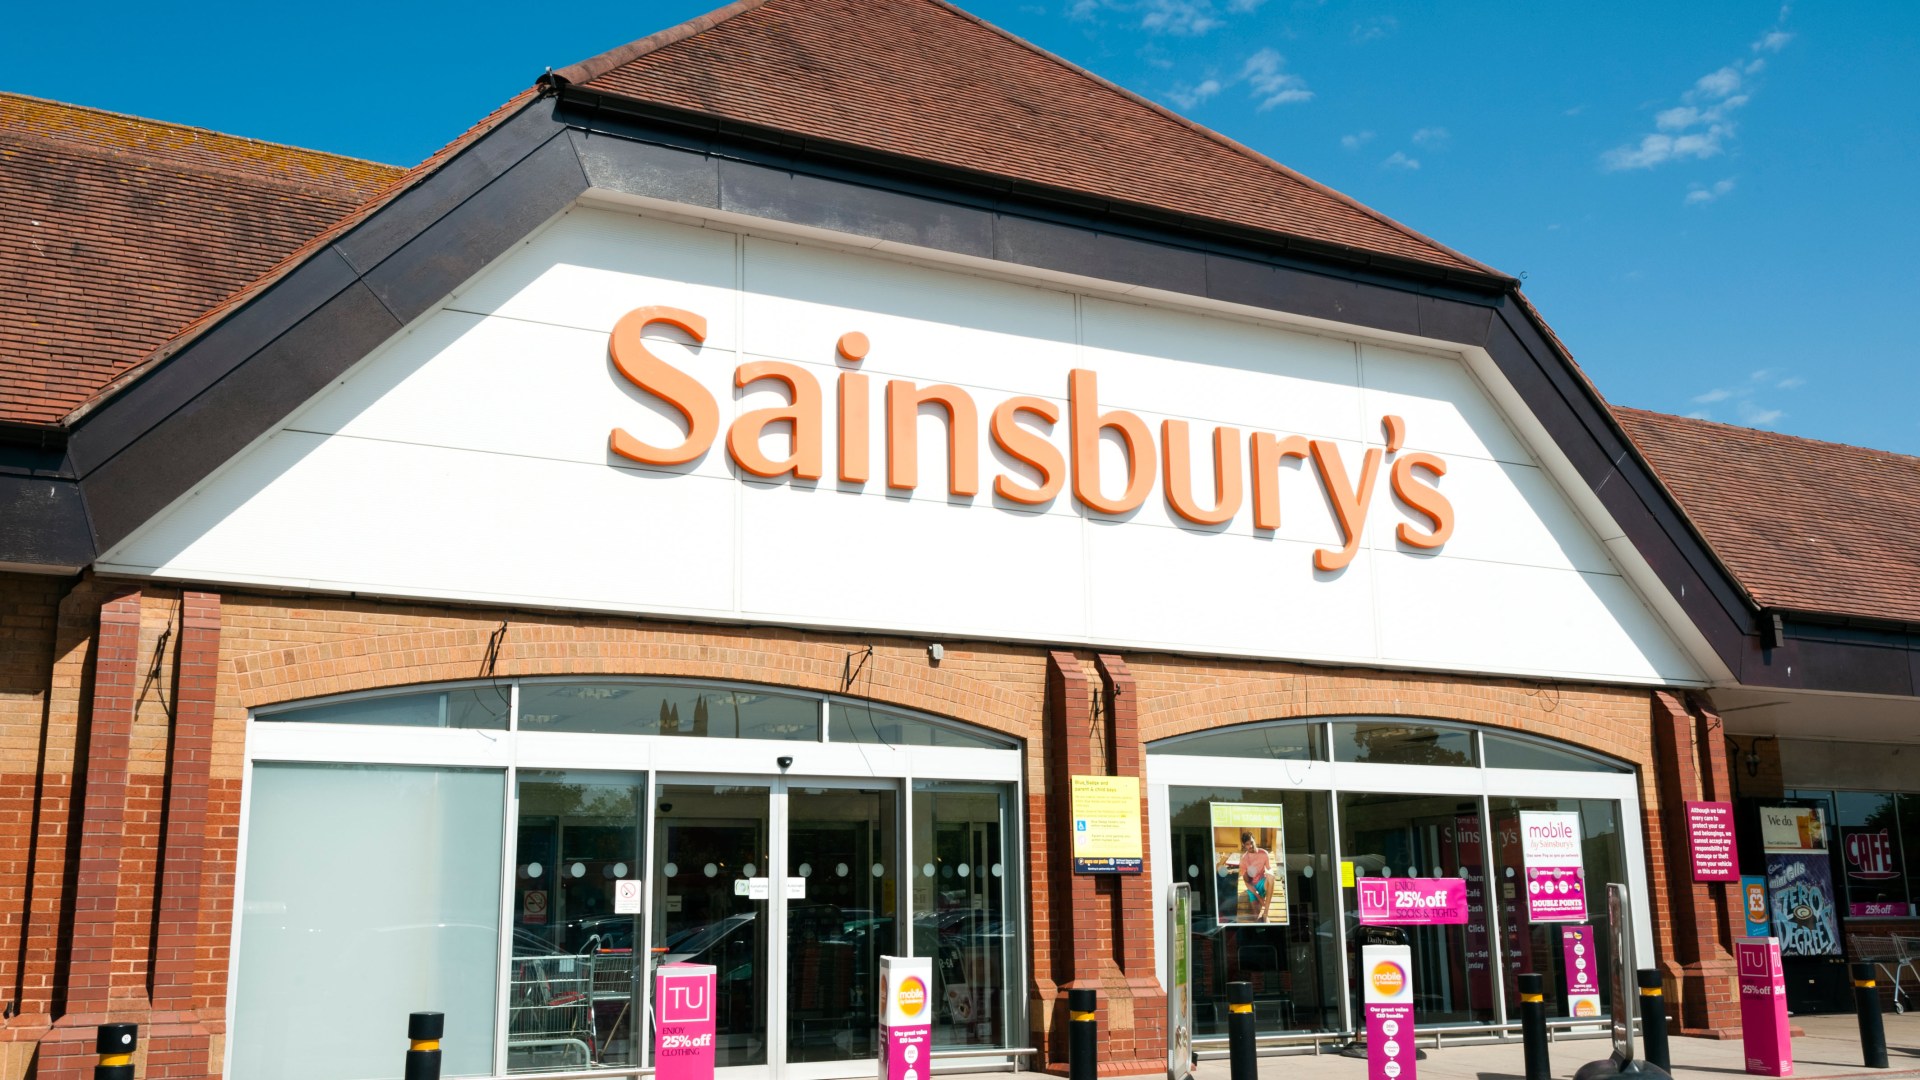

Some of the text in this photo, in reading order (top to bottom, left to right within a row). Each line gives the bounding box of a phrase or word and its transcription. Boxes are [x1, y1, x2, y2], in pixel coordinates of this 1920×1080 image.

[609, 305, 1455, 571] Sainsbury's
[1767, 814, 1781, 825] We
[1530, 821, 1572, 838] mobile
[1364, 881, 1416, 907] TU ENJOY
[1395, 890, 1447, 908] 25% off
[1750, 894, 1764, 912] £3
[1775, 881, 1824, 921] ZERO
[1396, 908, 1458, 918] SOCKS & TIGHTS
[1468, 904, 1482, 912] Cash
[1865, 904, 1892, 914] 25% off
[1468, 925, 1485, 933] Click
[1742, 951, 1764, 968] TU
[1374, 972, 1401, 980] mobile
[900, 988, 923, 998] mobile
[1743, 985, 1759, 994] 25%
[1760, 986, 1771, 995] off
[669, 986, 703, 1009] TU
[662, 1034, 711, 1048] 25% off
[662, 1048, 699, 1056] CLOTHING
